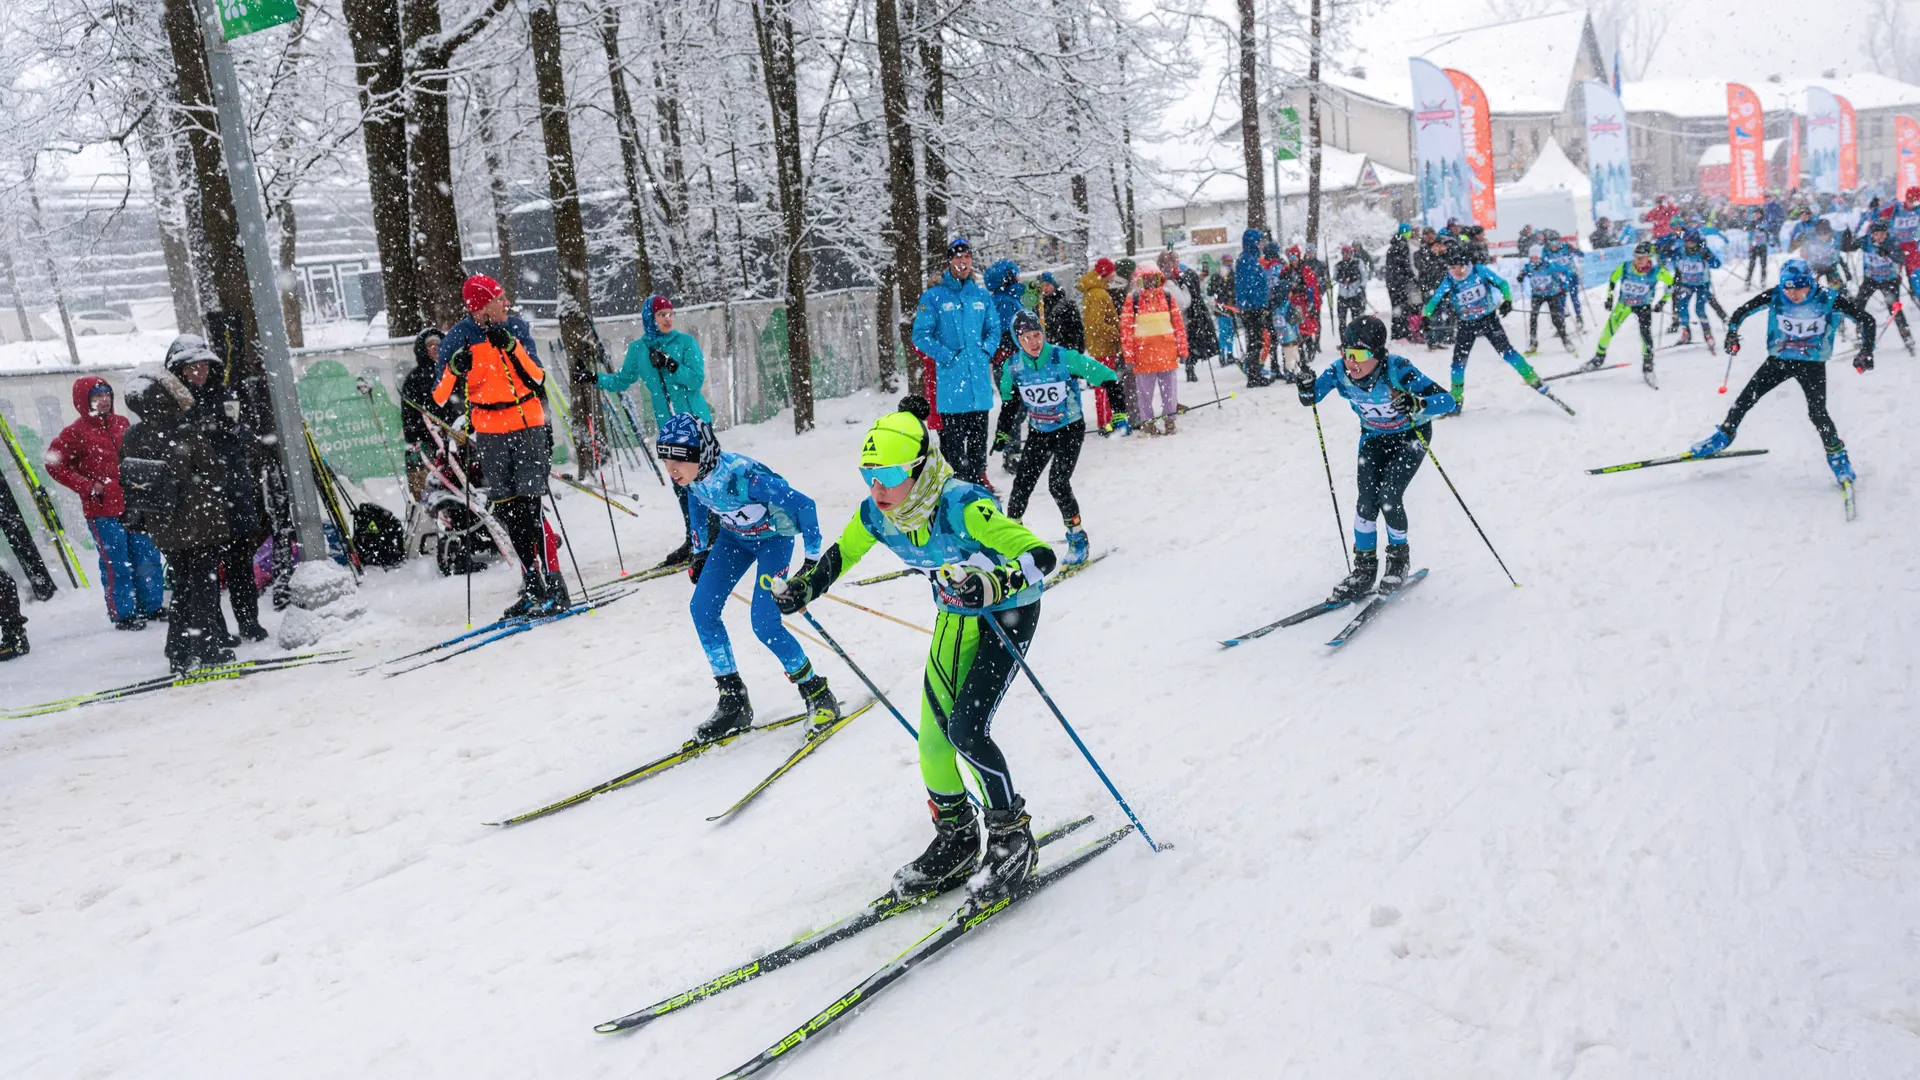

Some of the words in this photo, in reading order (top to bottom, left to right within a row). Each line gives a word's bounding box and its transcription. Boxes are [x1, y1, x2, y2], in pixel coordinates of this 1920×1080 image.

[1783, 319, 1818, 334] 914
[1025, 386, 1060, 404] 926
[172, 671, 240, 688] BRADOS
[996, 840, 1029, 876] FISCHER
[963, 897, 1011, 932] FISCHER
[653, 961, 760, 1015] FISCHER
[767, 988, 861, 1057] FISCHER
